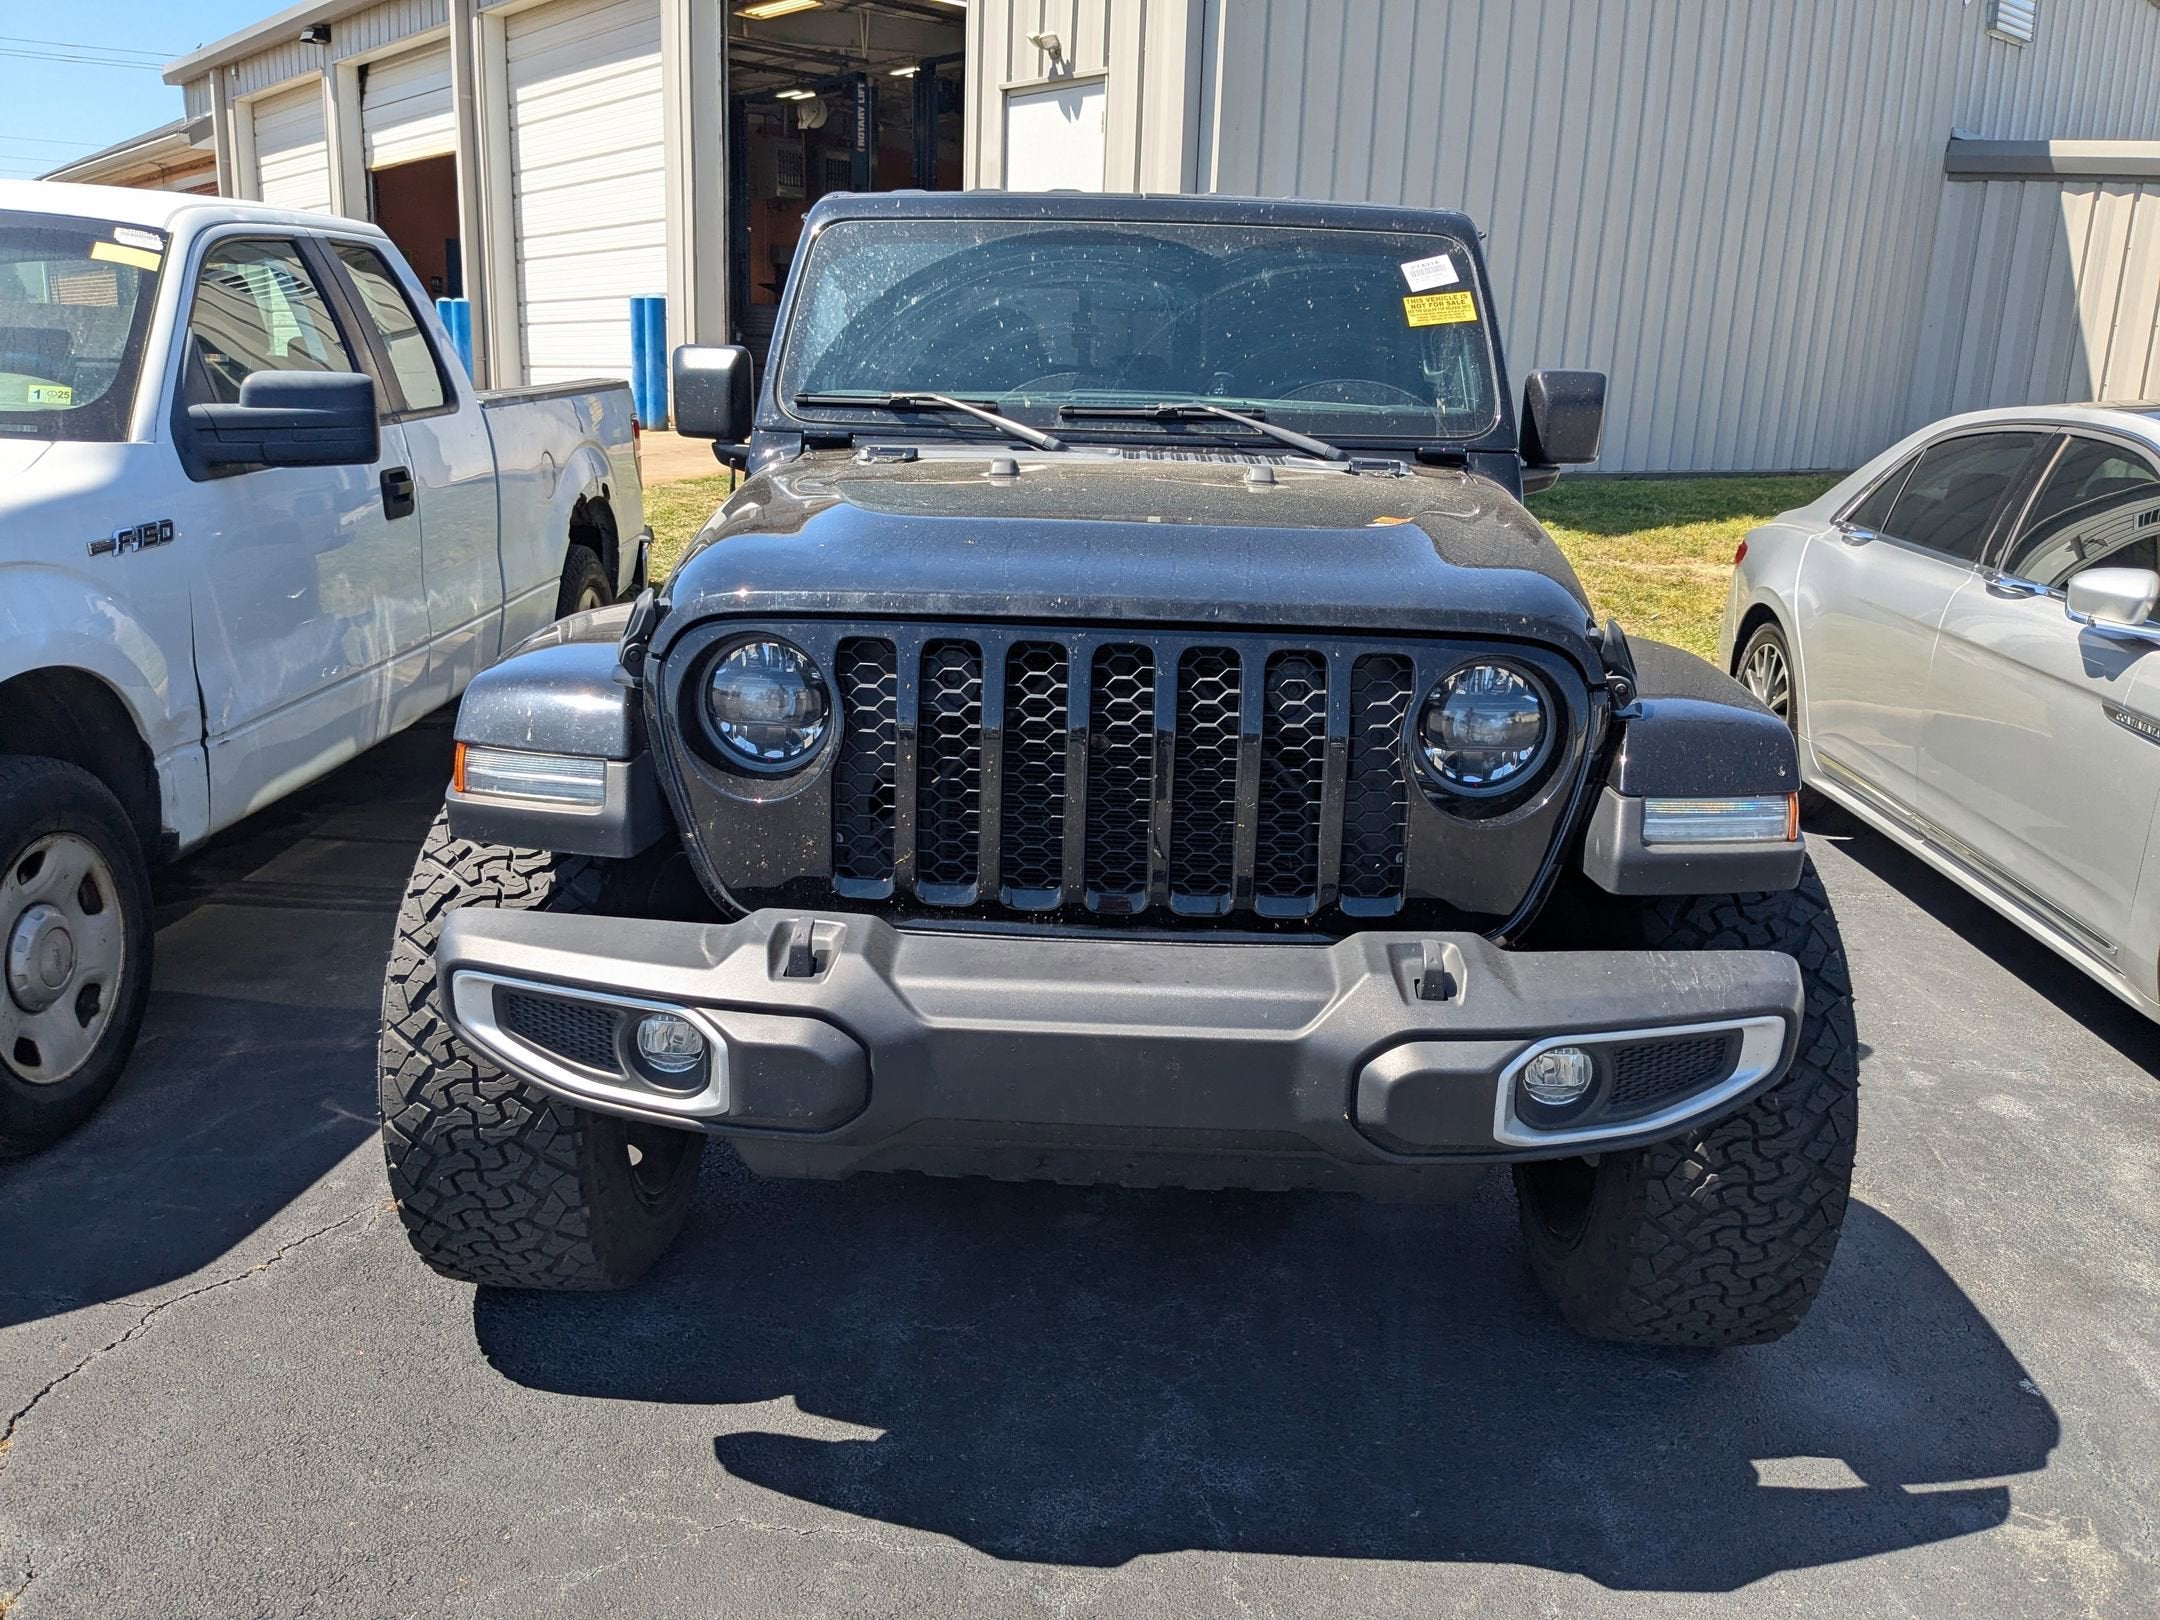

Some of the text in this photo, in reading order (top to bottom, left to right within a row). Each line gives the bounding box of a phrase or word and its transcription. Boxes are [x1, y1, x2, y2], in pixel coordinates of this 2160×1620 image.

[857, 81, 865, 147] ROTARY LIFT
[1406, 297, 1424, 305] THIS
[1425, 294, 1459, 303] VEHICLE
[1410, 302, 1426, 310] NOT
[33, 389, 70, 399] 1 25
